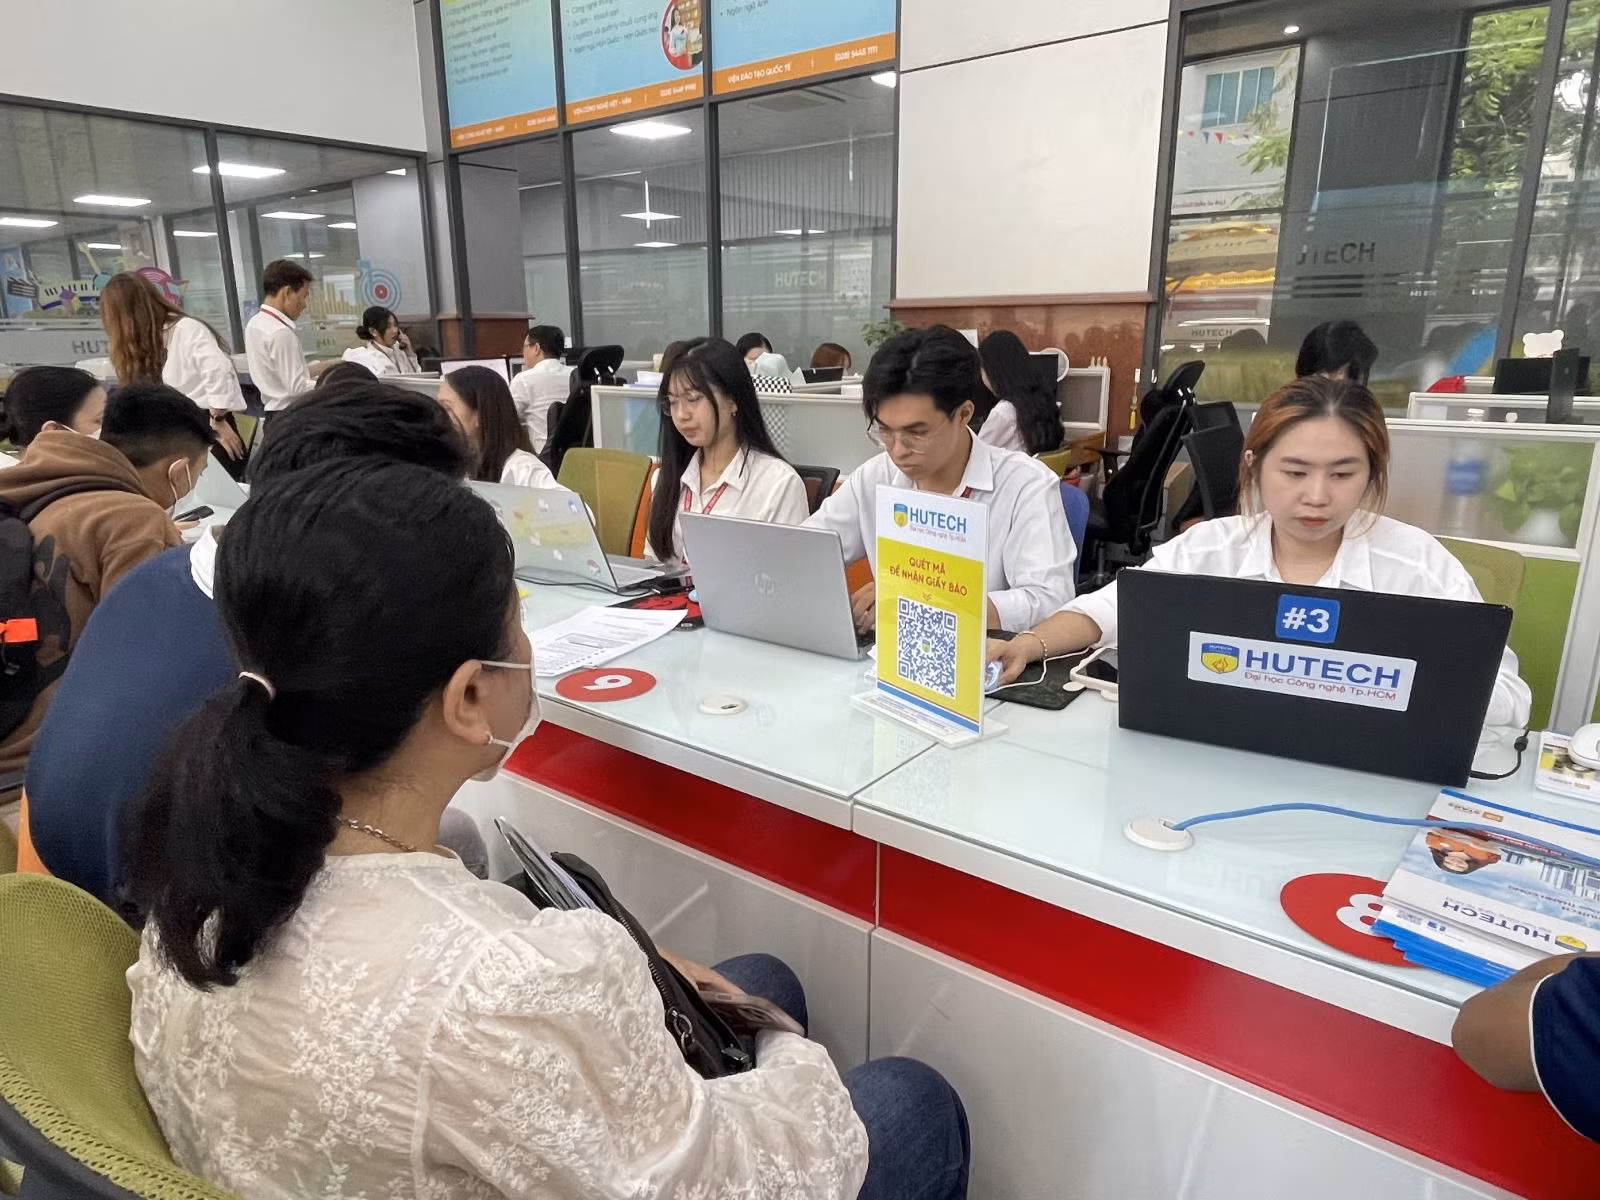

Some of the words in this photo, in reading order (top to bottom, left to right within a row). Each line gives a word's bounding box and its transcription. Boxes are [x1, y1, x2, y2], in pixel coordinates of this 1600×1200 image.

[728, 73, 740, 84] VIỆN
[740, 71, 753, 82] ĐÀO
[753, 68, 765, 79] TẠO
[766, 64, 784, 76] QUỐC
[775, 270, 827, 288] HUTECH
[72, 340, 109, 354] HUT
[909, 506, 967, 534] HUTECH
[890, 564, 900, 576] ĐỂ
[902, 569, 924, 584] NHẬN
[926, 576, 947, 590] GIẤY
[948, 582, 968, 596] BÁO
[909, 557, 930, 571] QUÉT
[932, 562, 946, 575] MÃ
[1282, 606, 1330, 634] #3
[582, 674, 633, 691] 9
[1245, 649, 1401, 689] HUTECH
[1244, 671, 1262, 681] Đại
[1263, 674, 1284, 685] học
[1287, 677, 1316, 692] Công
[1319, 682, 1346, 695] nghệ
[1350, 686, 1397, 702] Tp.HCM
[1442, 900, 1551, 942] HUTECH
